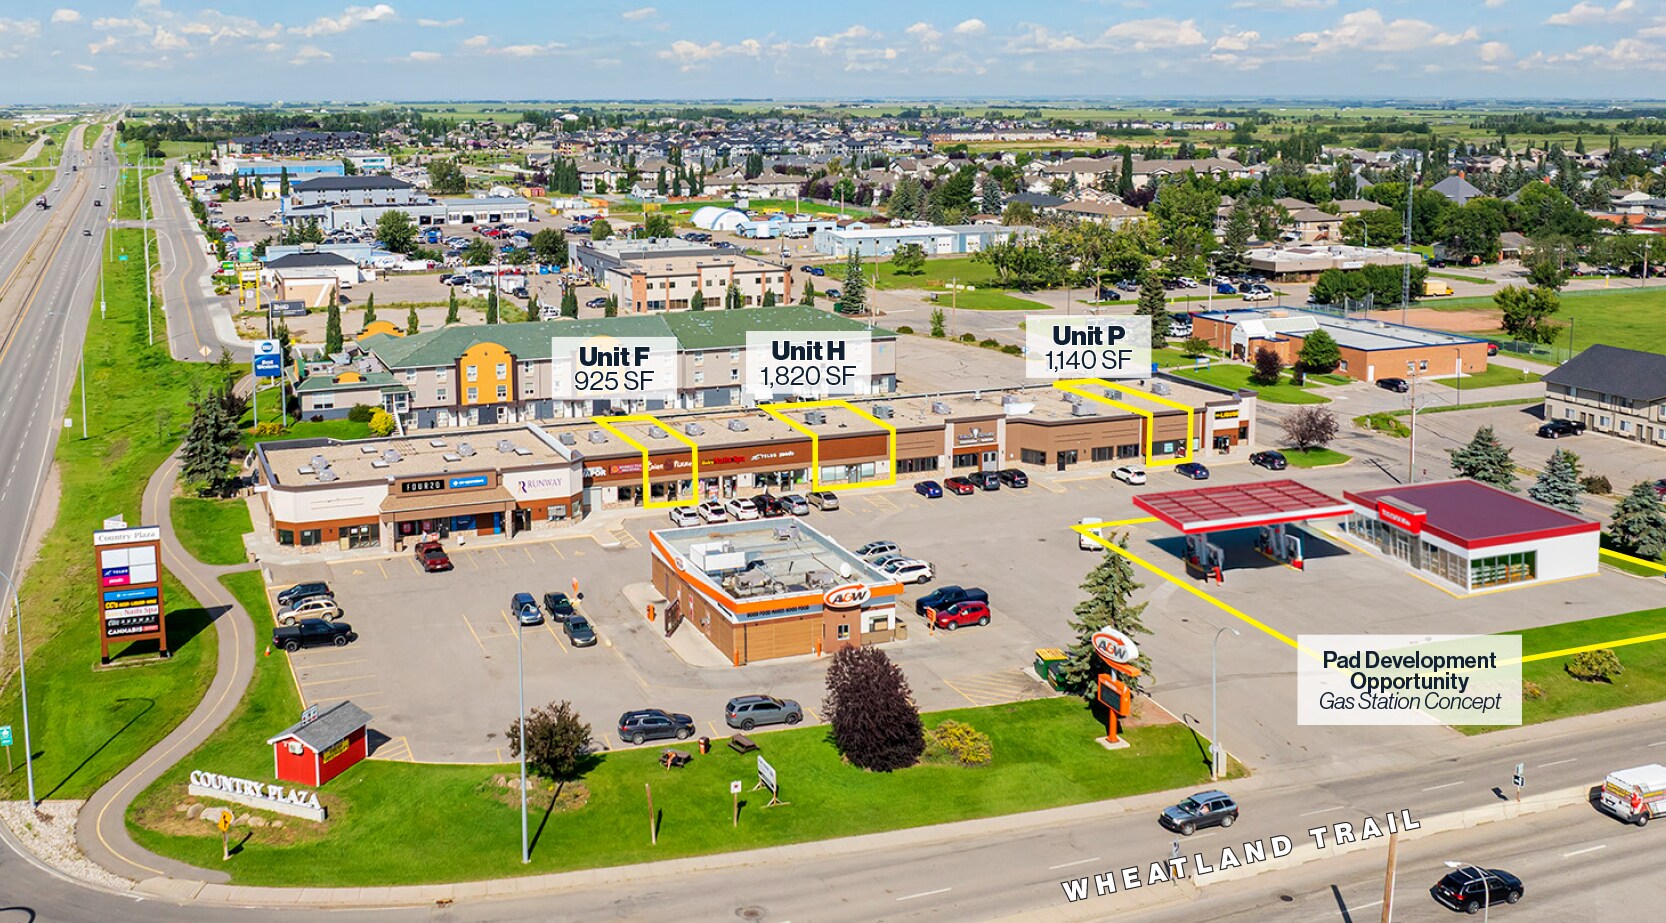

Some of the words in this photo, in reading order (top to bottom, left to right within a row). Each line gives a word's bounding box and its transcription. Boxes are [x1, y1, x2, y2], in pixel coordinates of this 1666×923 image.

[527, 478, 563, 489] RUNWAY
[98, 533, 131, 543] Country
[134, 530, 156, 539] Plaza
[832, 590, 868, 604] A&W
[1098, 640, 1127, 660] A&W
[190, 769, 264, 798] COUNTRY
[267, 784, 321, 809] PLAZA
